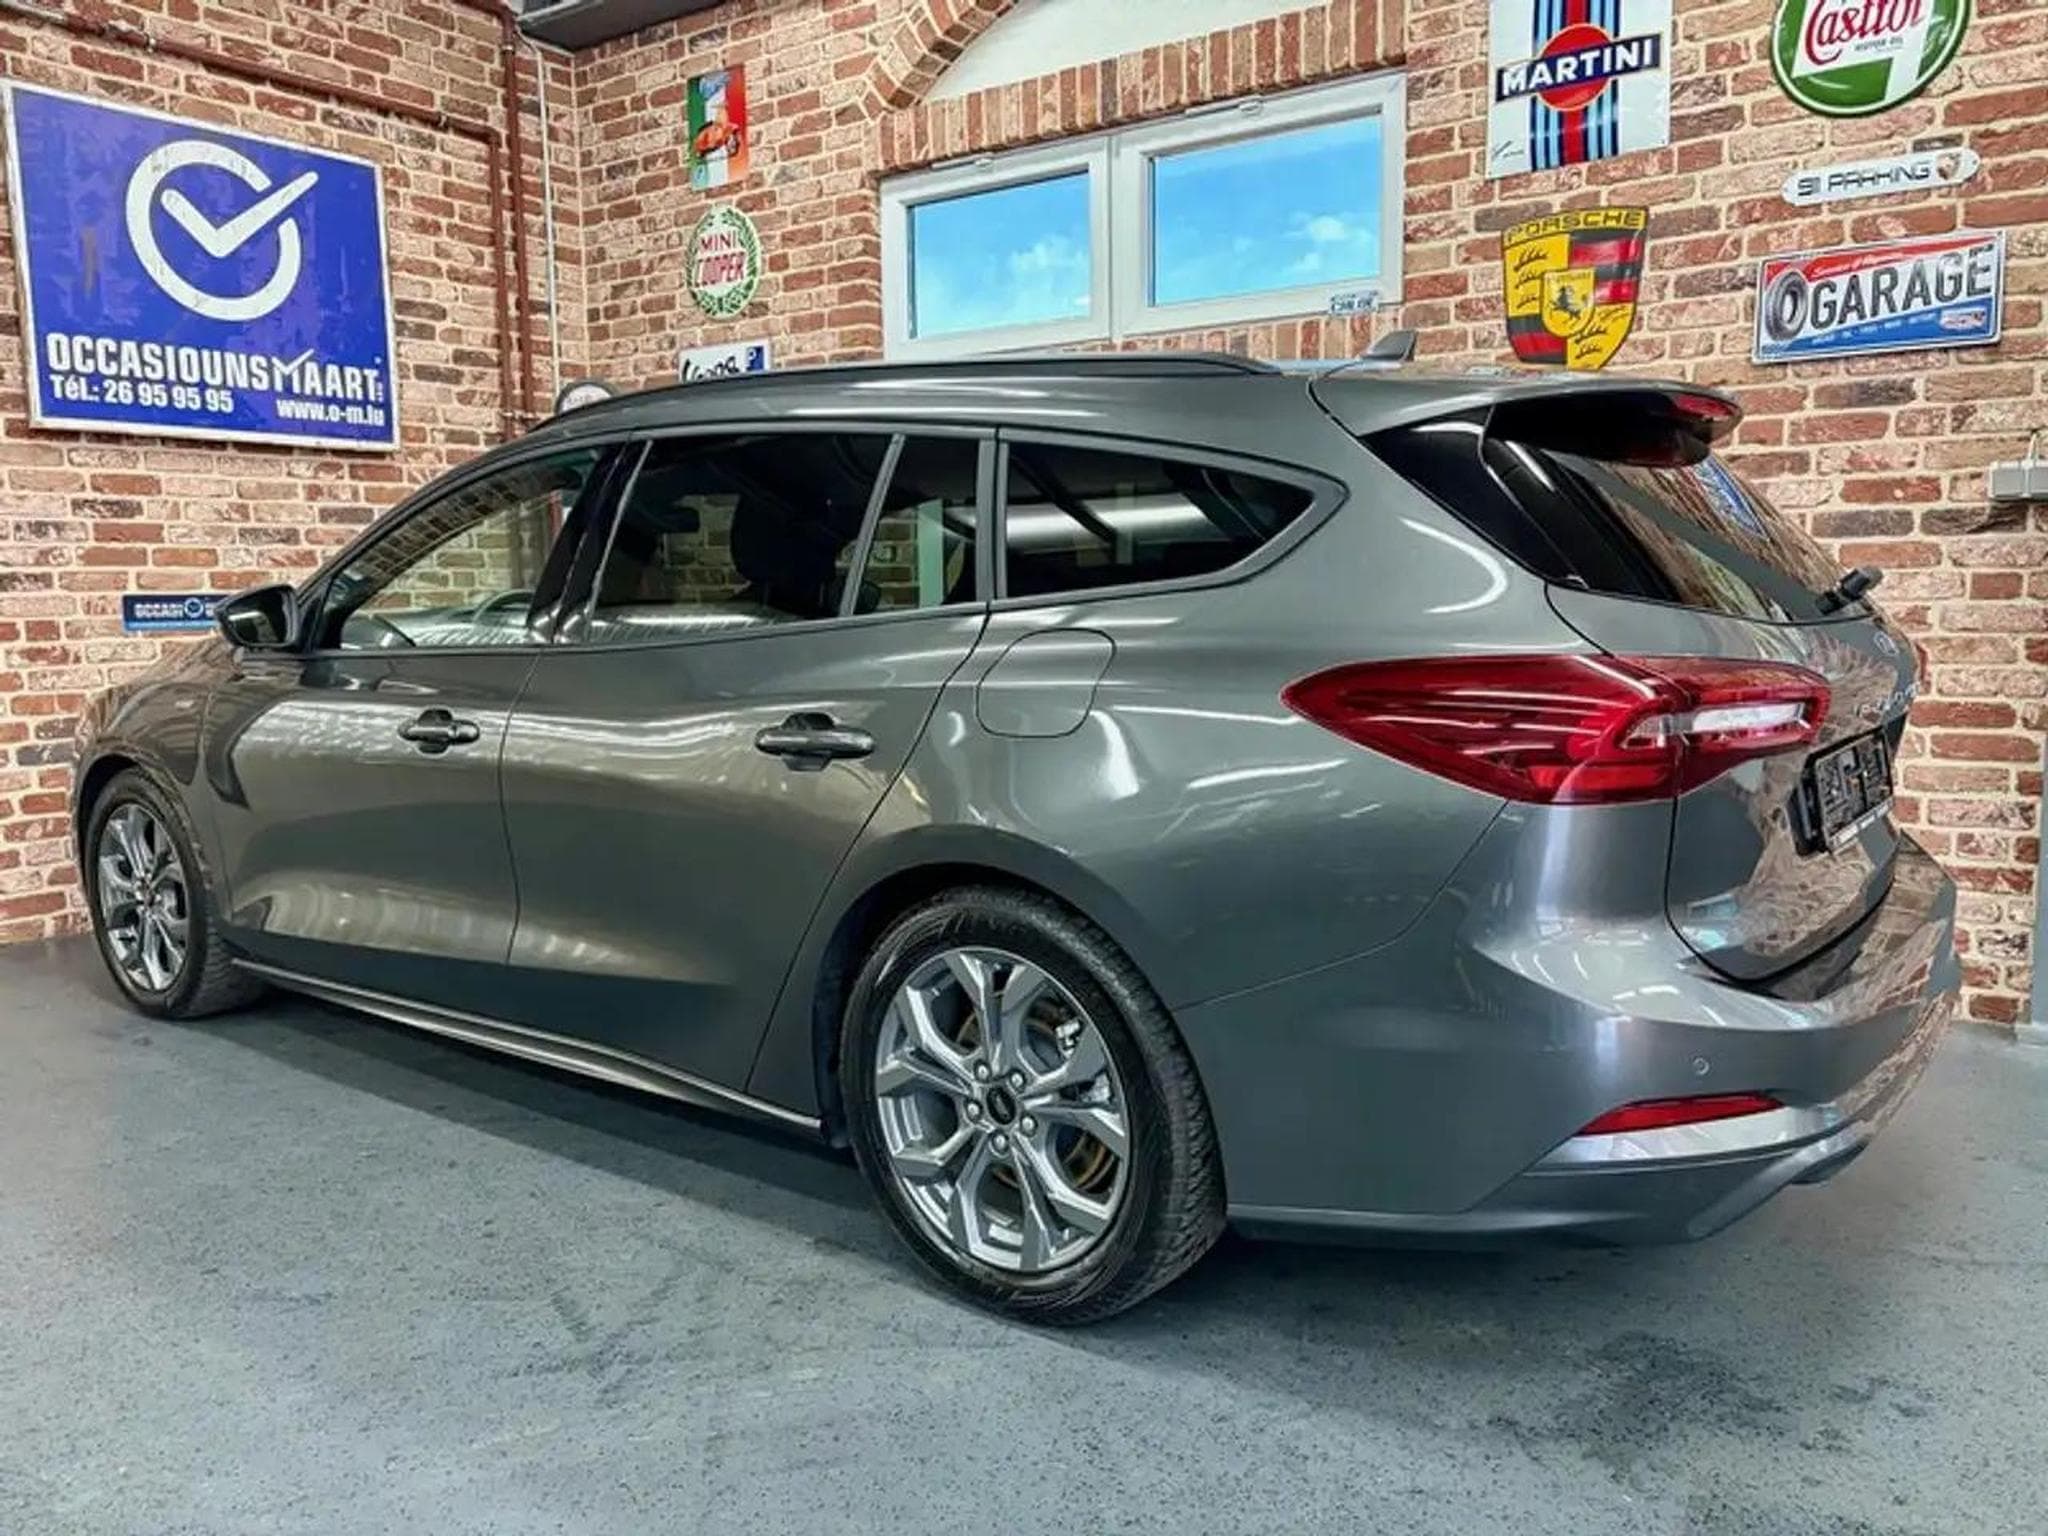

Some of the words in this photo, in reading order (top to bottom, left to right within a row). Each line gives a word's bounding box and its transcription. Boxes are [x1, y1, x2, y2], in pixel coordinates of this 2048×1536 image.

[1502, 38, 1654, 97] MARTINI
[1828, 160, 1931, 193] PARKING
[701, 231, 737, 251] MINI
[1505, 211, 1642, 244] PORSCHE
[695, 252, 744, 287] COOPER
[104, 380, 133, 403] 26
[137, 385, 168, 408] 95
[173, 388, 202, 411] 95
[205, 389, 235, 414] 95
[275, 399, 386, 427] www.o-m.lu
